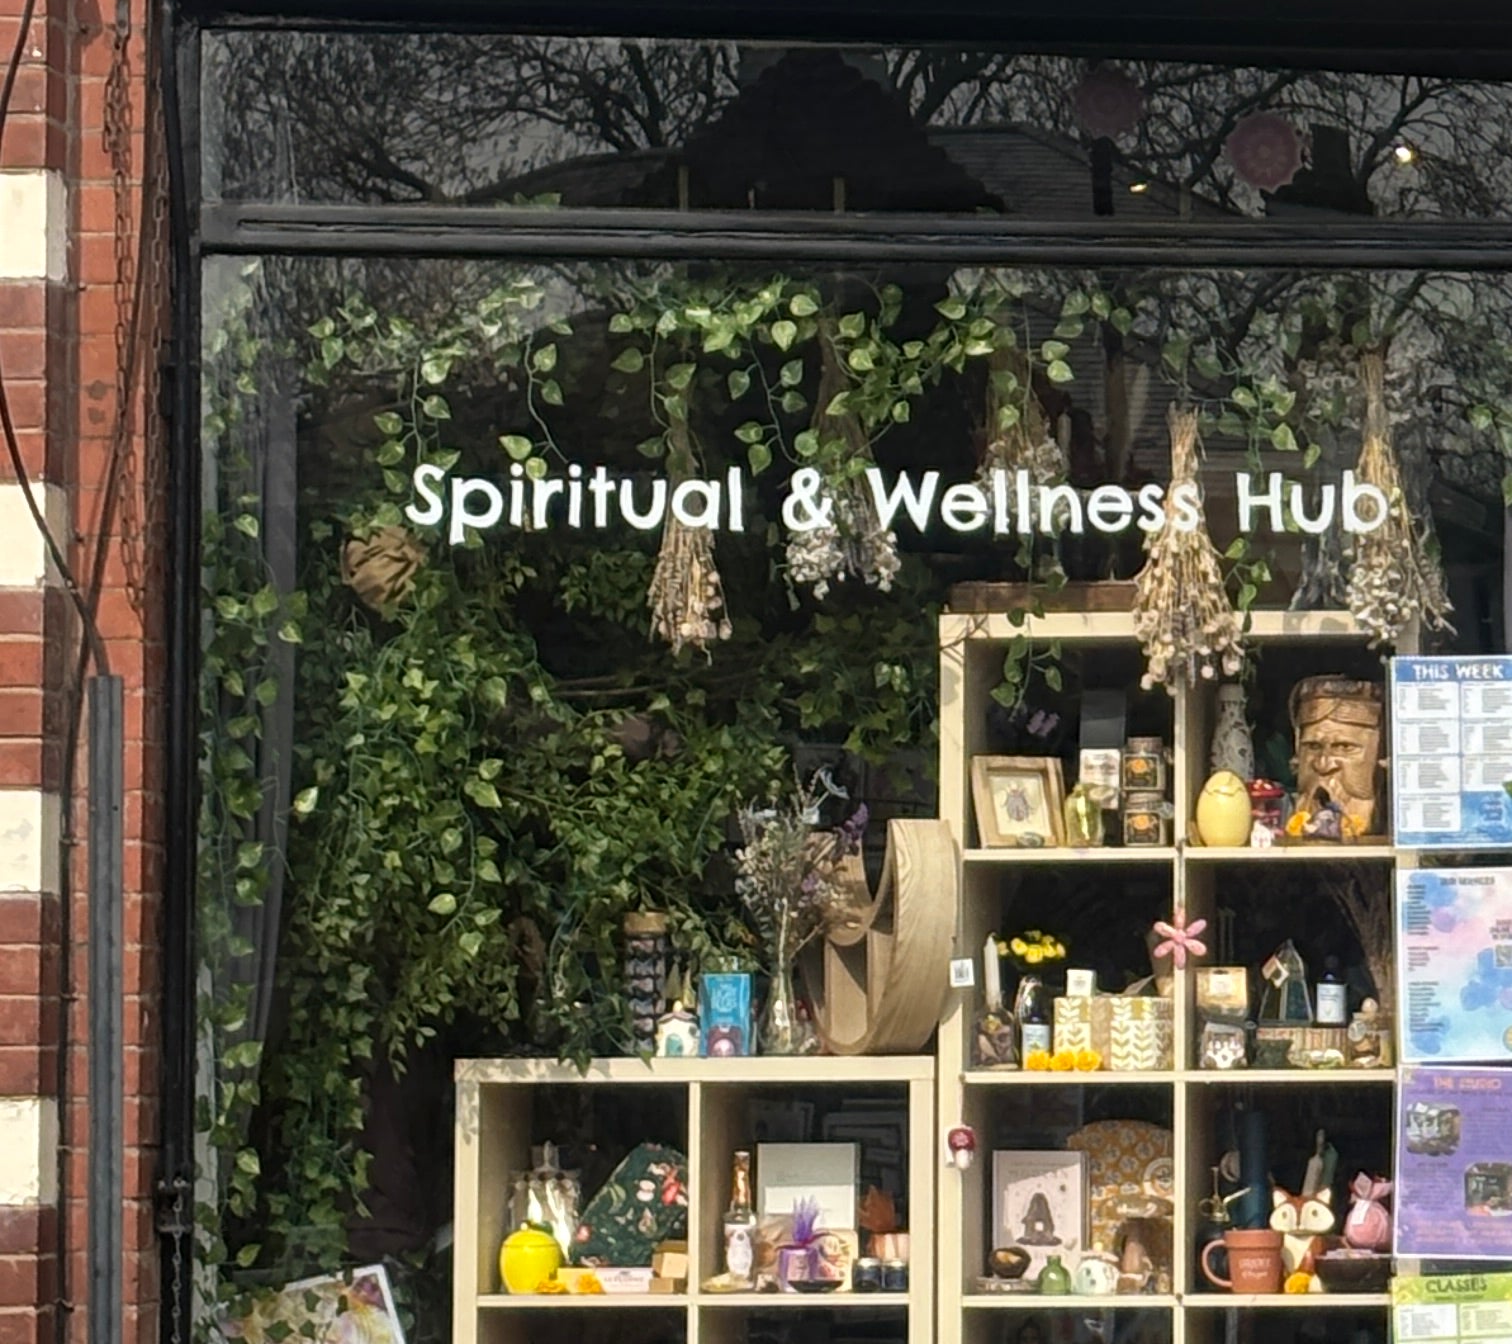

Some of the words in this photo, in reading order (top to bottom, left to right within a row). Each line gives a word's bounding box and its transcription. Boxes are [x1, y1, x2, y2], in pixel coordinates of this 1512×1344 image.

[405, 463, 744, 546] Spiritual
[781, 467, 834, 532] &
[866, 467, 1202, 535] Wellness
[1236, 469, 1389, 534] Hub
[1412, 663, 1450, 681] THIS
[1455, 662, 1505, 680] WEEK
[1425, 1276, 1488, 1294] CLASSES
